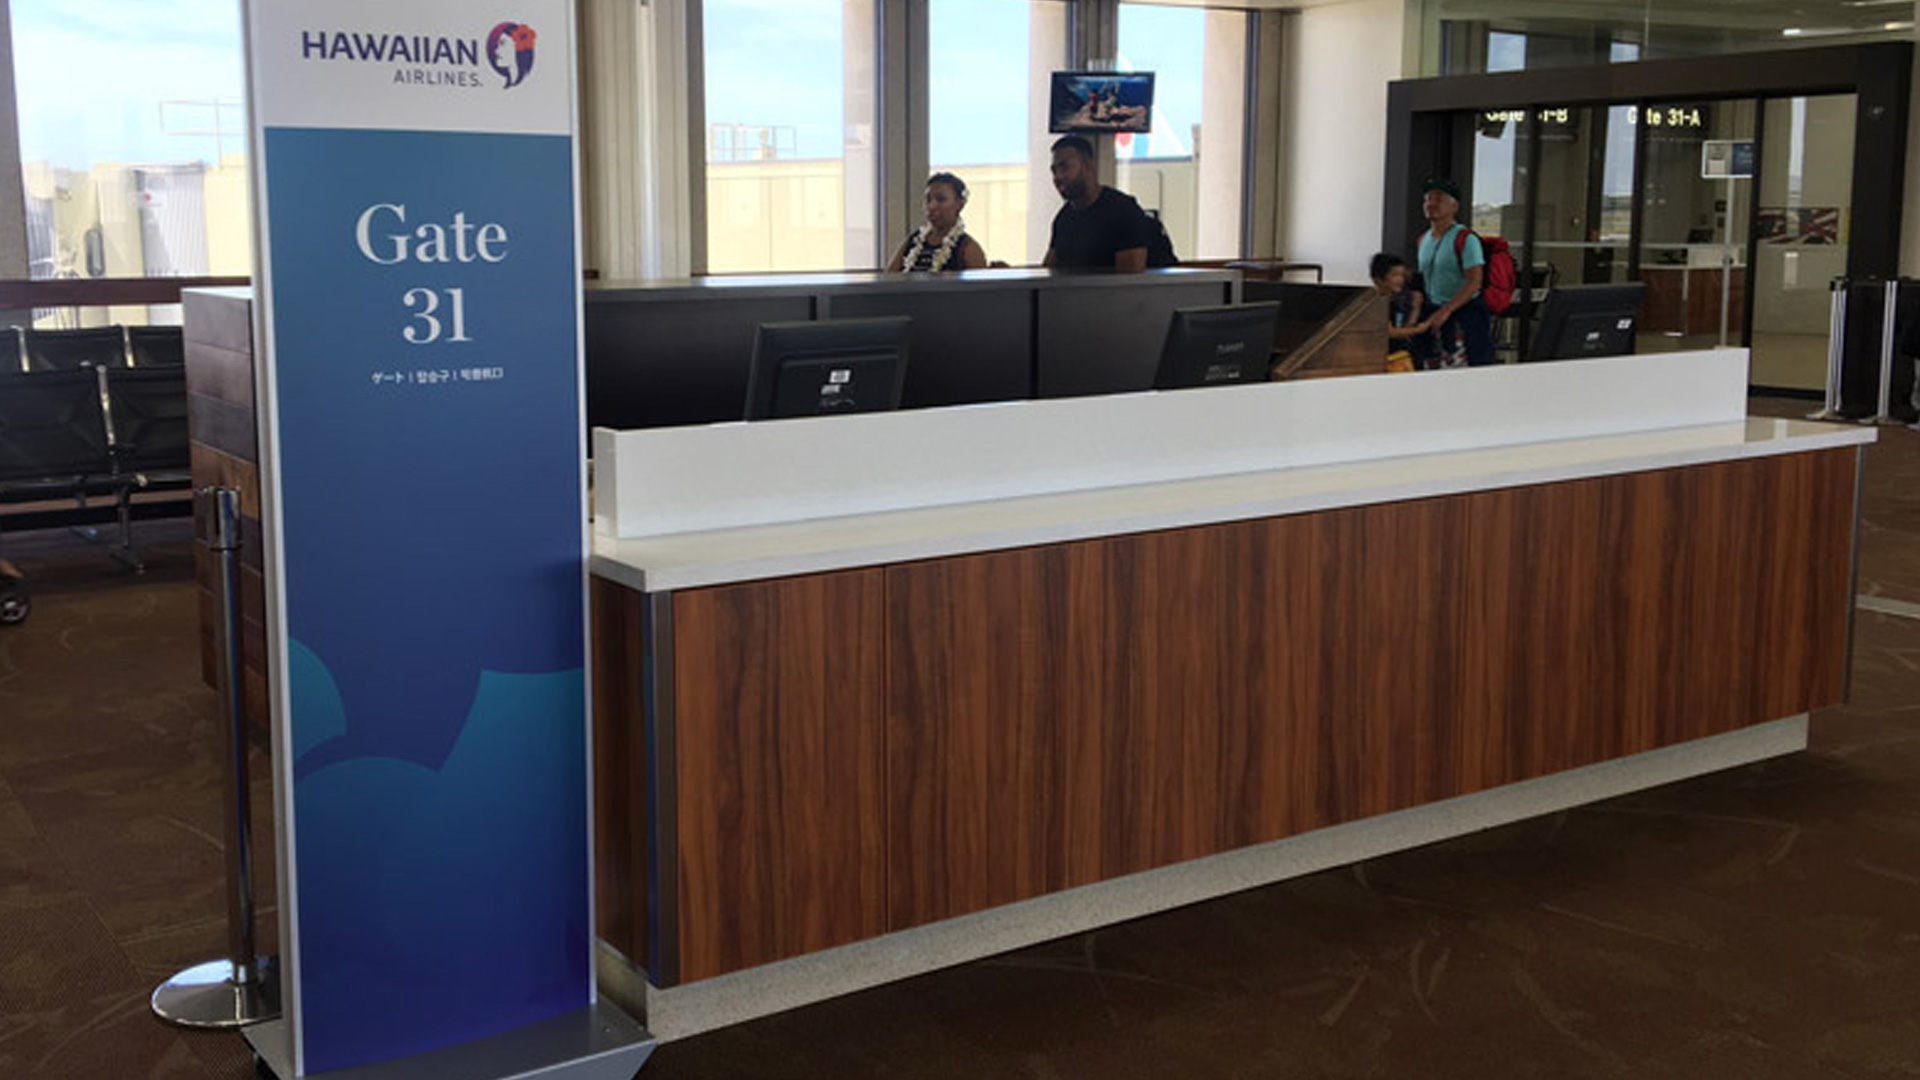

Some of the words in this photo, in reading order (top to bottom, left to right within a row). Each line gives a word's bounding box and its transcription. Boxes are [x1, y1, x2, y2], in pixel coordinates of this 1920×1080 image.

[302, 30, 479, 66] HAWAIIAN
[1537, 108, 1568, 123] 1-B
[1627, 105, 1661, 126] Gte
[1667, 107, 1701, 127] 31-A
[356, 203, 508, 265] Gate
[403, 287, 474, 344] 31
